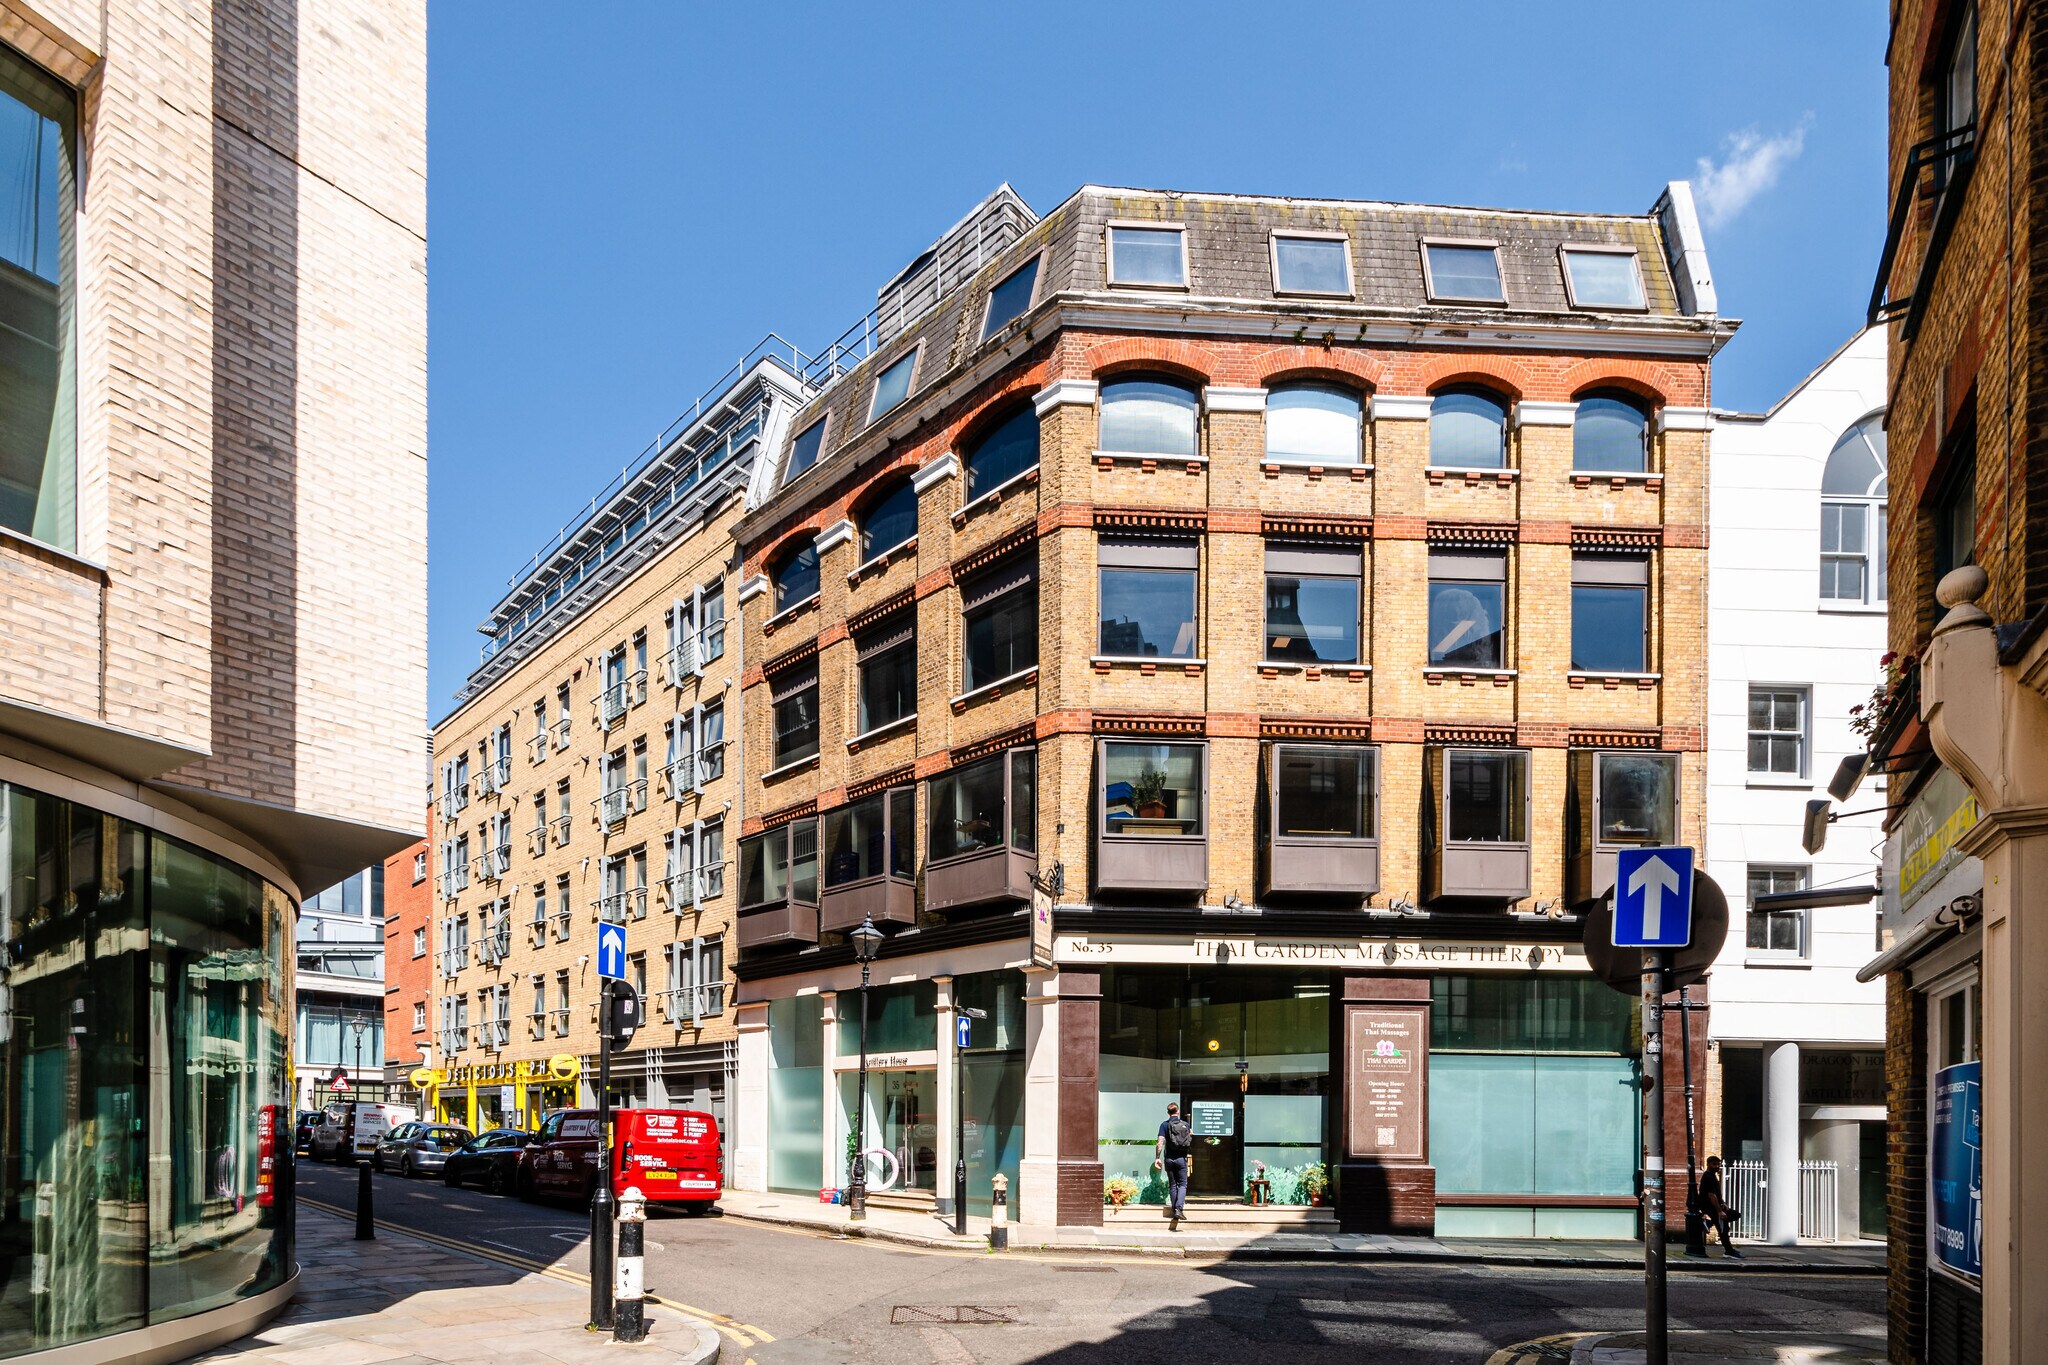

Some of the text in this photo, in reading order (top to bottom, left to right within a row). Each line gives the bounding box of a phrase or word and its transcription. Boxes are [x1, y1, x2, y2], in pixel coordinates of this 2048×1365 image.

[1072, 941, 1113, 953] No. 35
[1194, 941, 1567, 963] THAI GARDEN MASSAGE THERAPY
[1369, 1021, 1404, 1029] Traditional
[1803, 1055, 1860, 1065] DRAGOON
[1846, 1071, 1860, 1084] 37
[893, 1080, 900, 1090] 35
[1803, 1089, 1866, 1099] ARTILLERY
[640, 1160, 667, 1168] SERVICE
